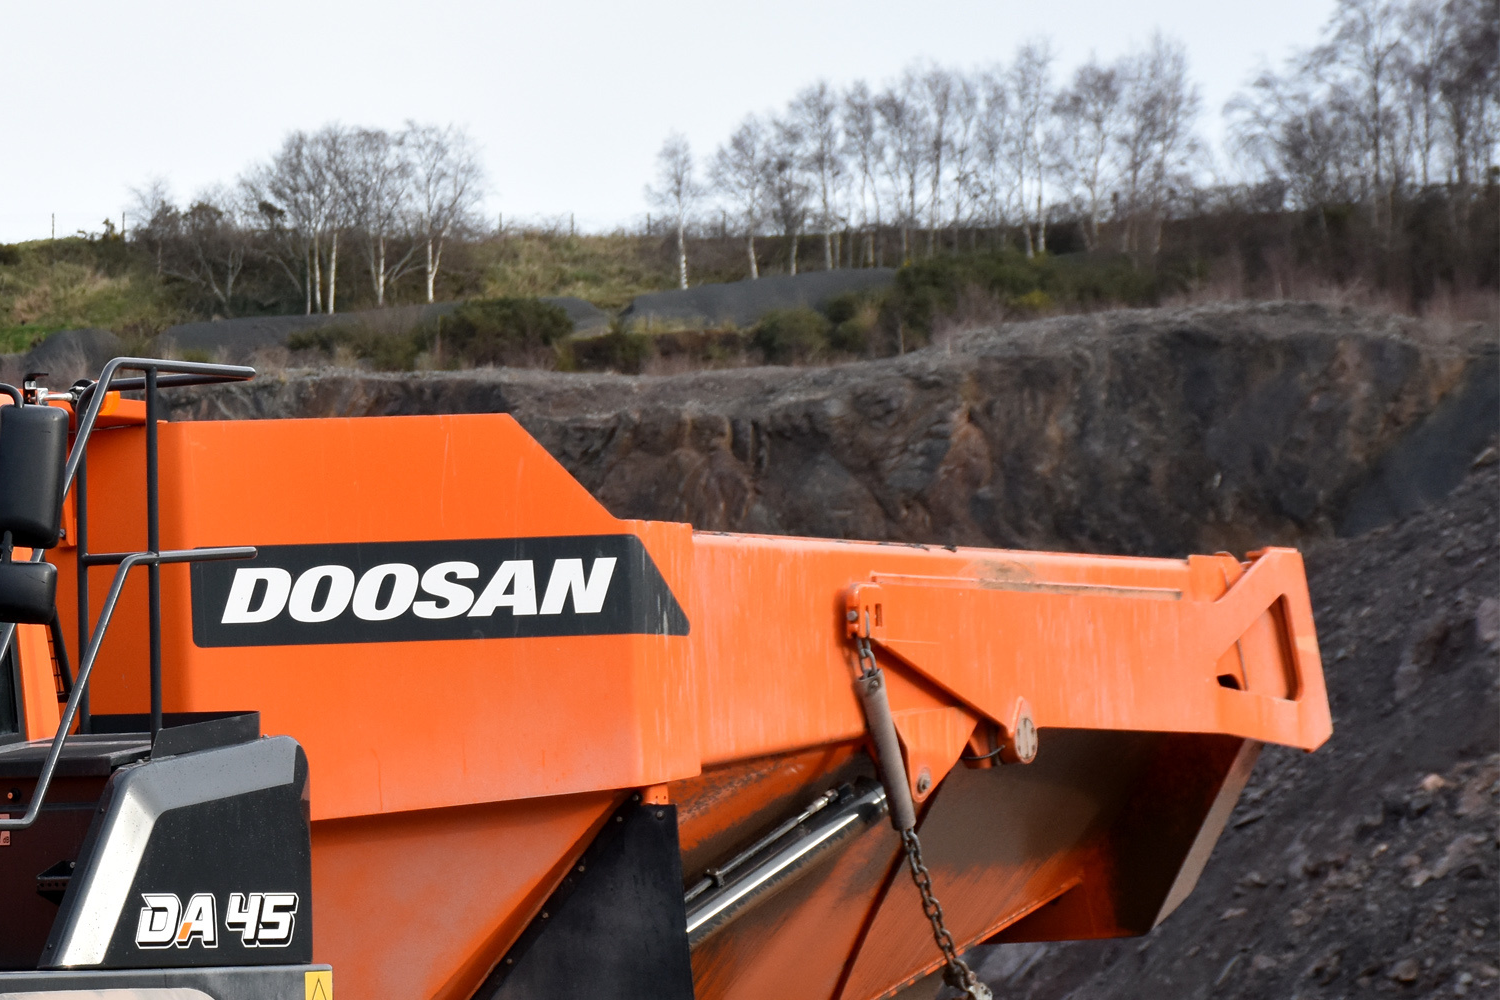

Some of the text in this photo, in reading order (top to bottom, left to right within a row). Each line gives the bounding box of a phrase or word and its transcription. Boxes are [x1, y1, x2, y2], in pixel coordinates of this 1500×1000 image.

[220, 556, 618, 625] DOOSAN
[135, 892, 299, 949] DA 45
